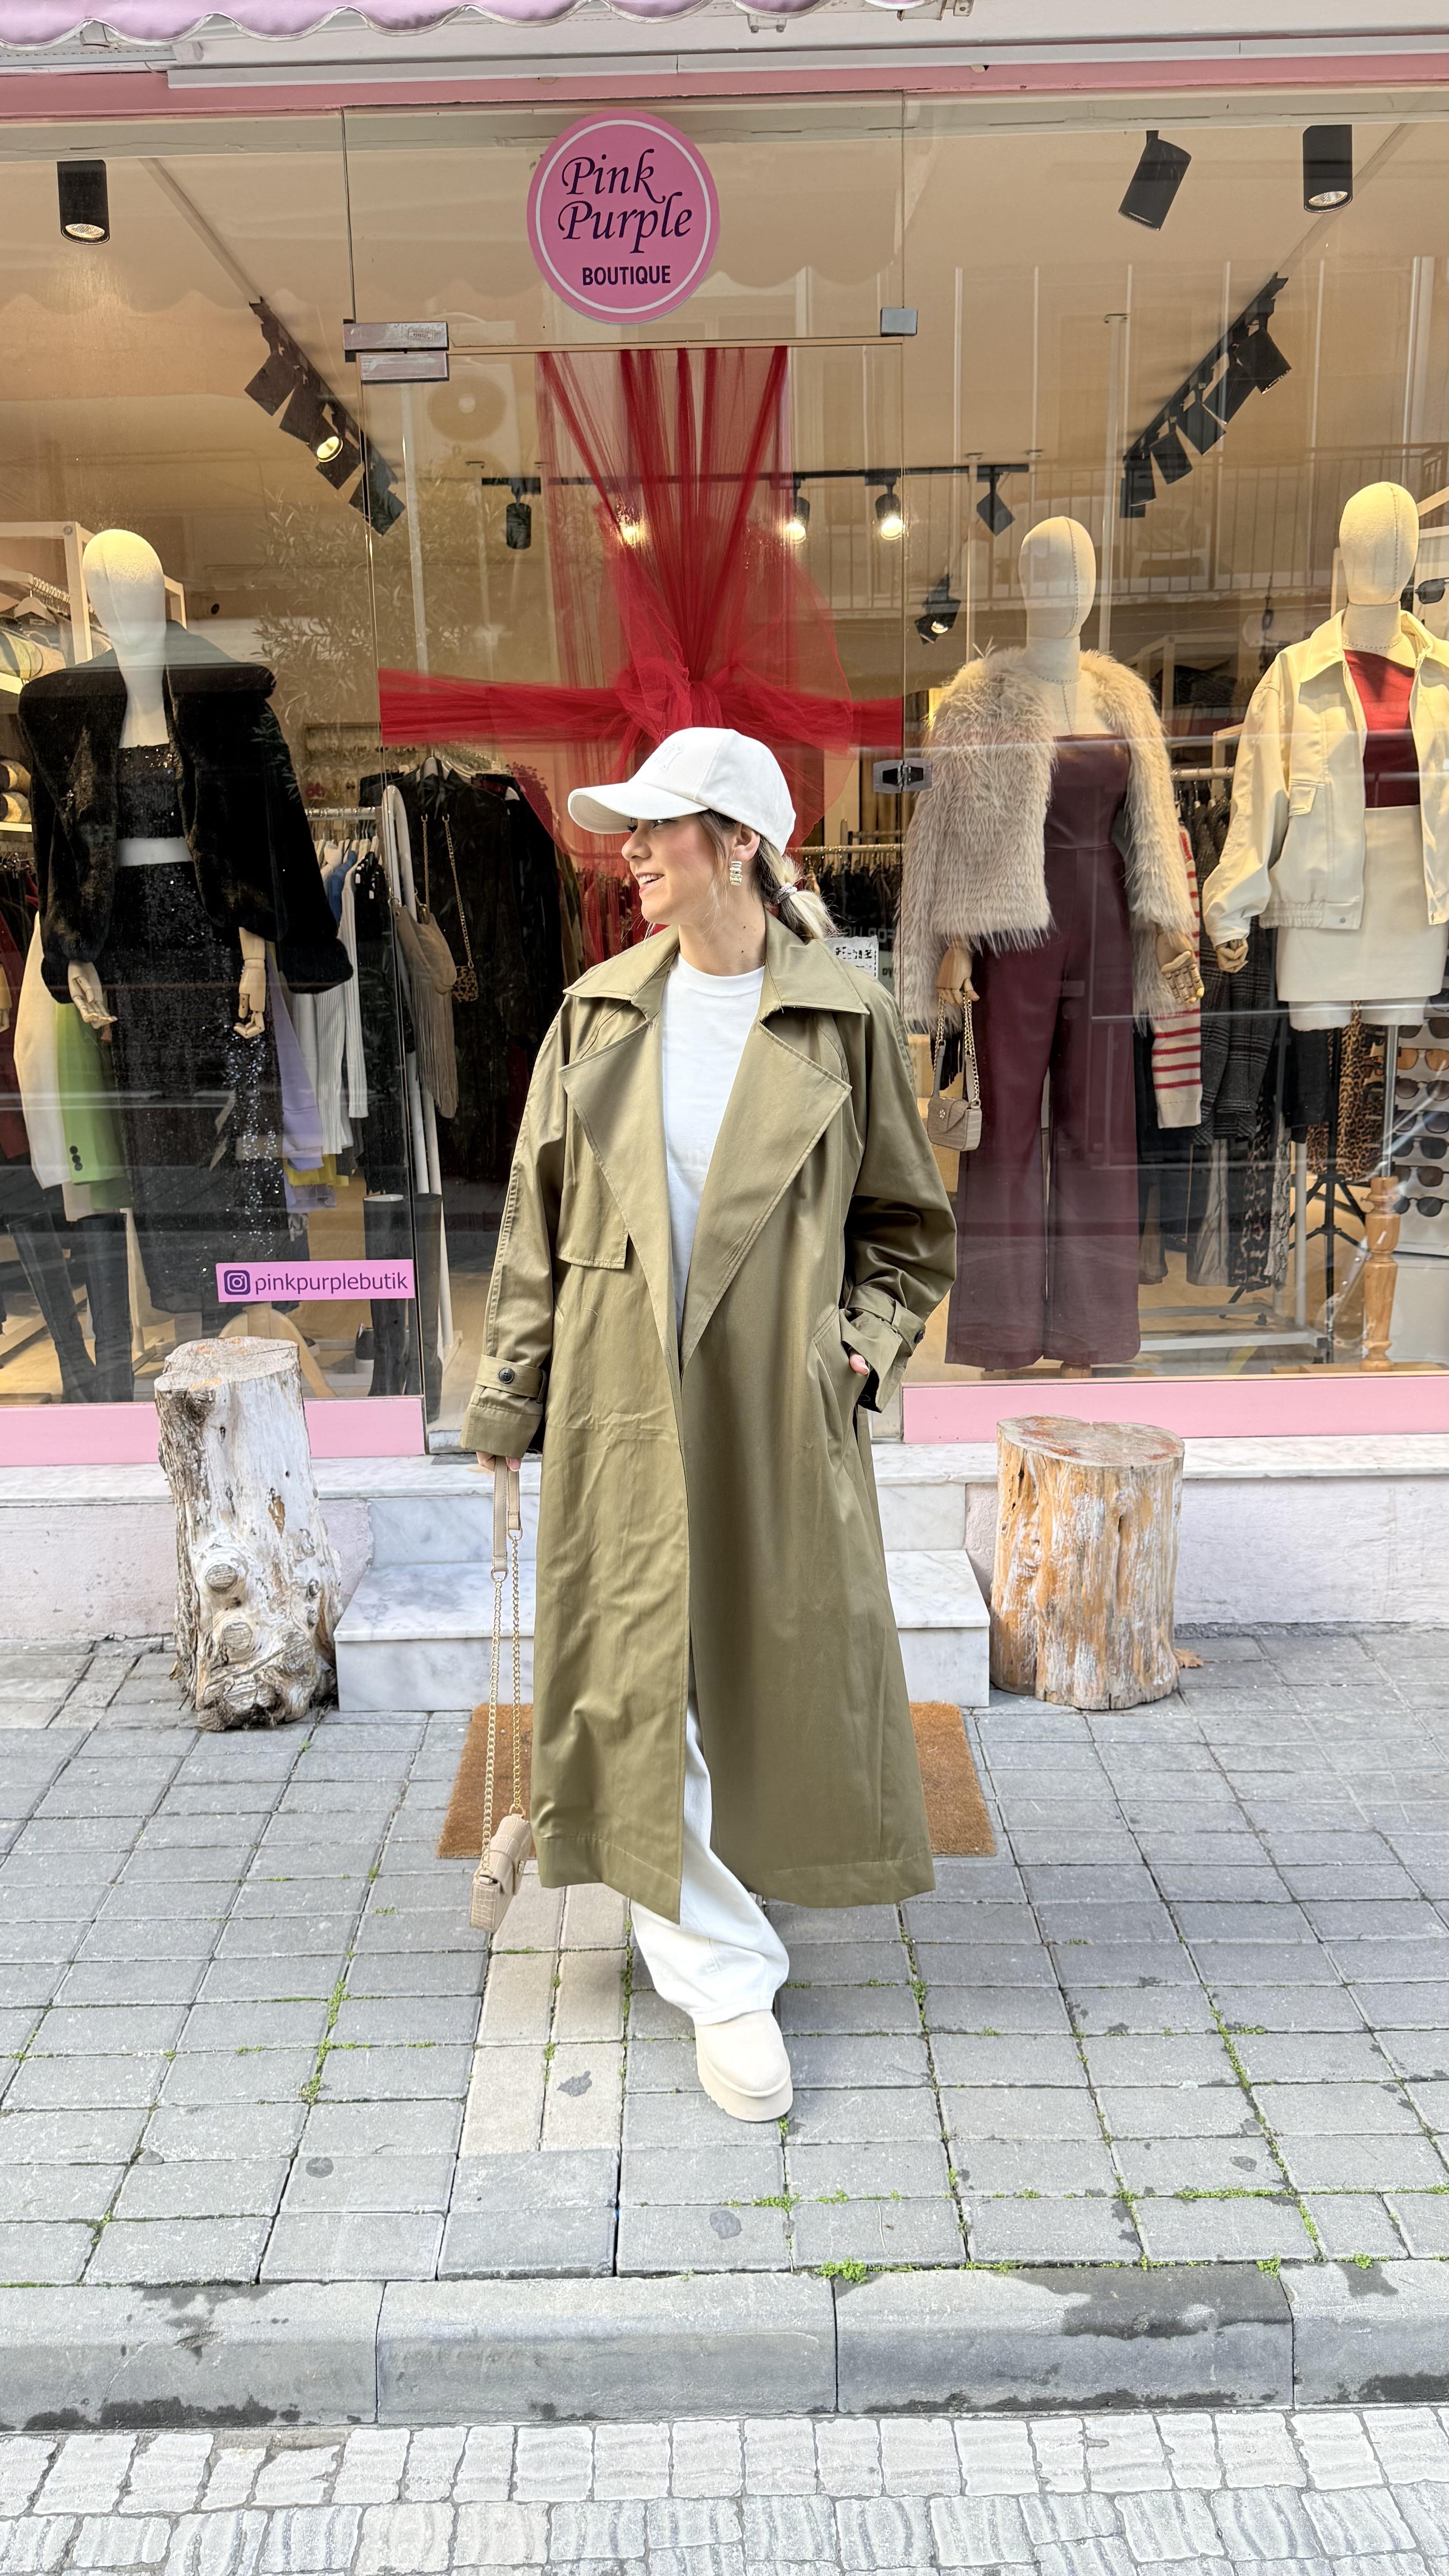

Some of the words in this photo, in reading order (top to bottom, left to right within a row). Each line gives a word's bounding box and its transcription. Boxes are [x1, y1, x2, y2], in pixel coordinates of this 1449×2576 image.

[562, 148, 666, 204] Pink
[558, 192, 692, 253] Purple
[582, 265, 671, 285] BOUTIQUE
[255, 1272, 408, 1295] pinkpurplebutik
